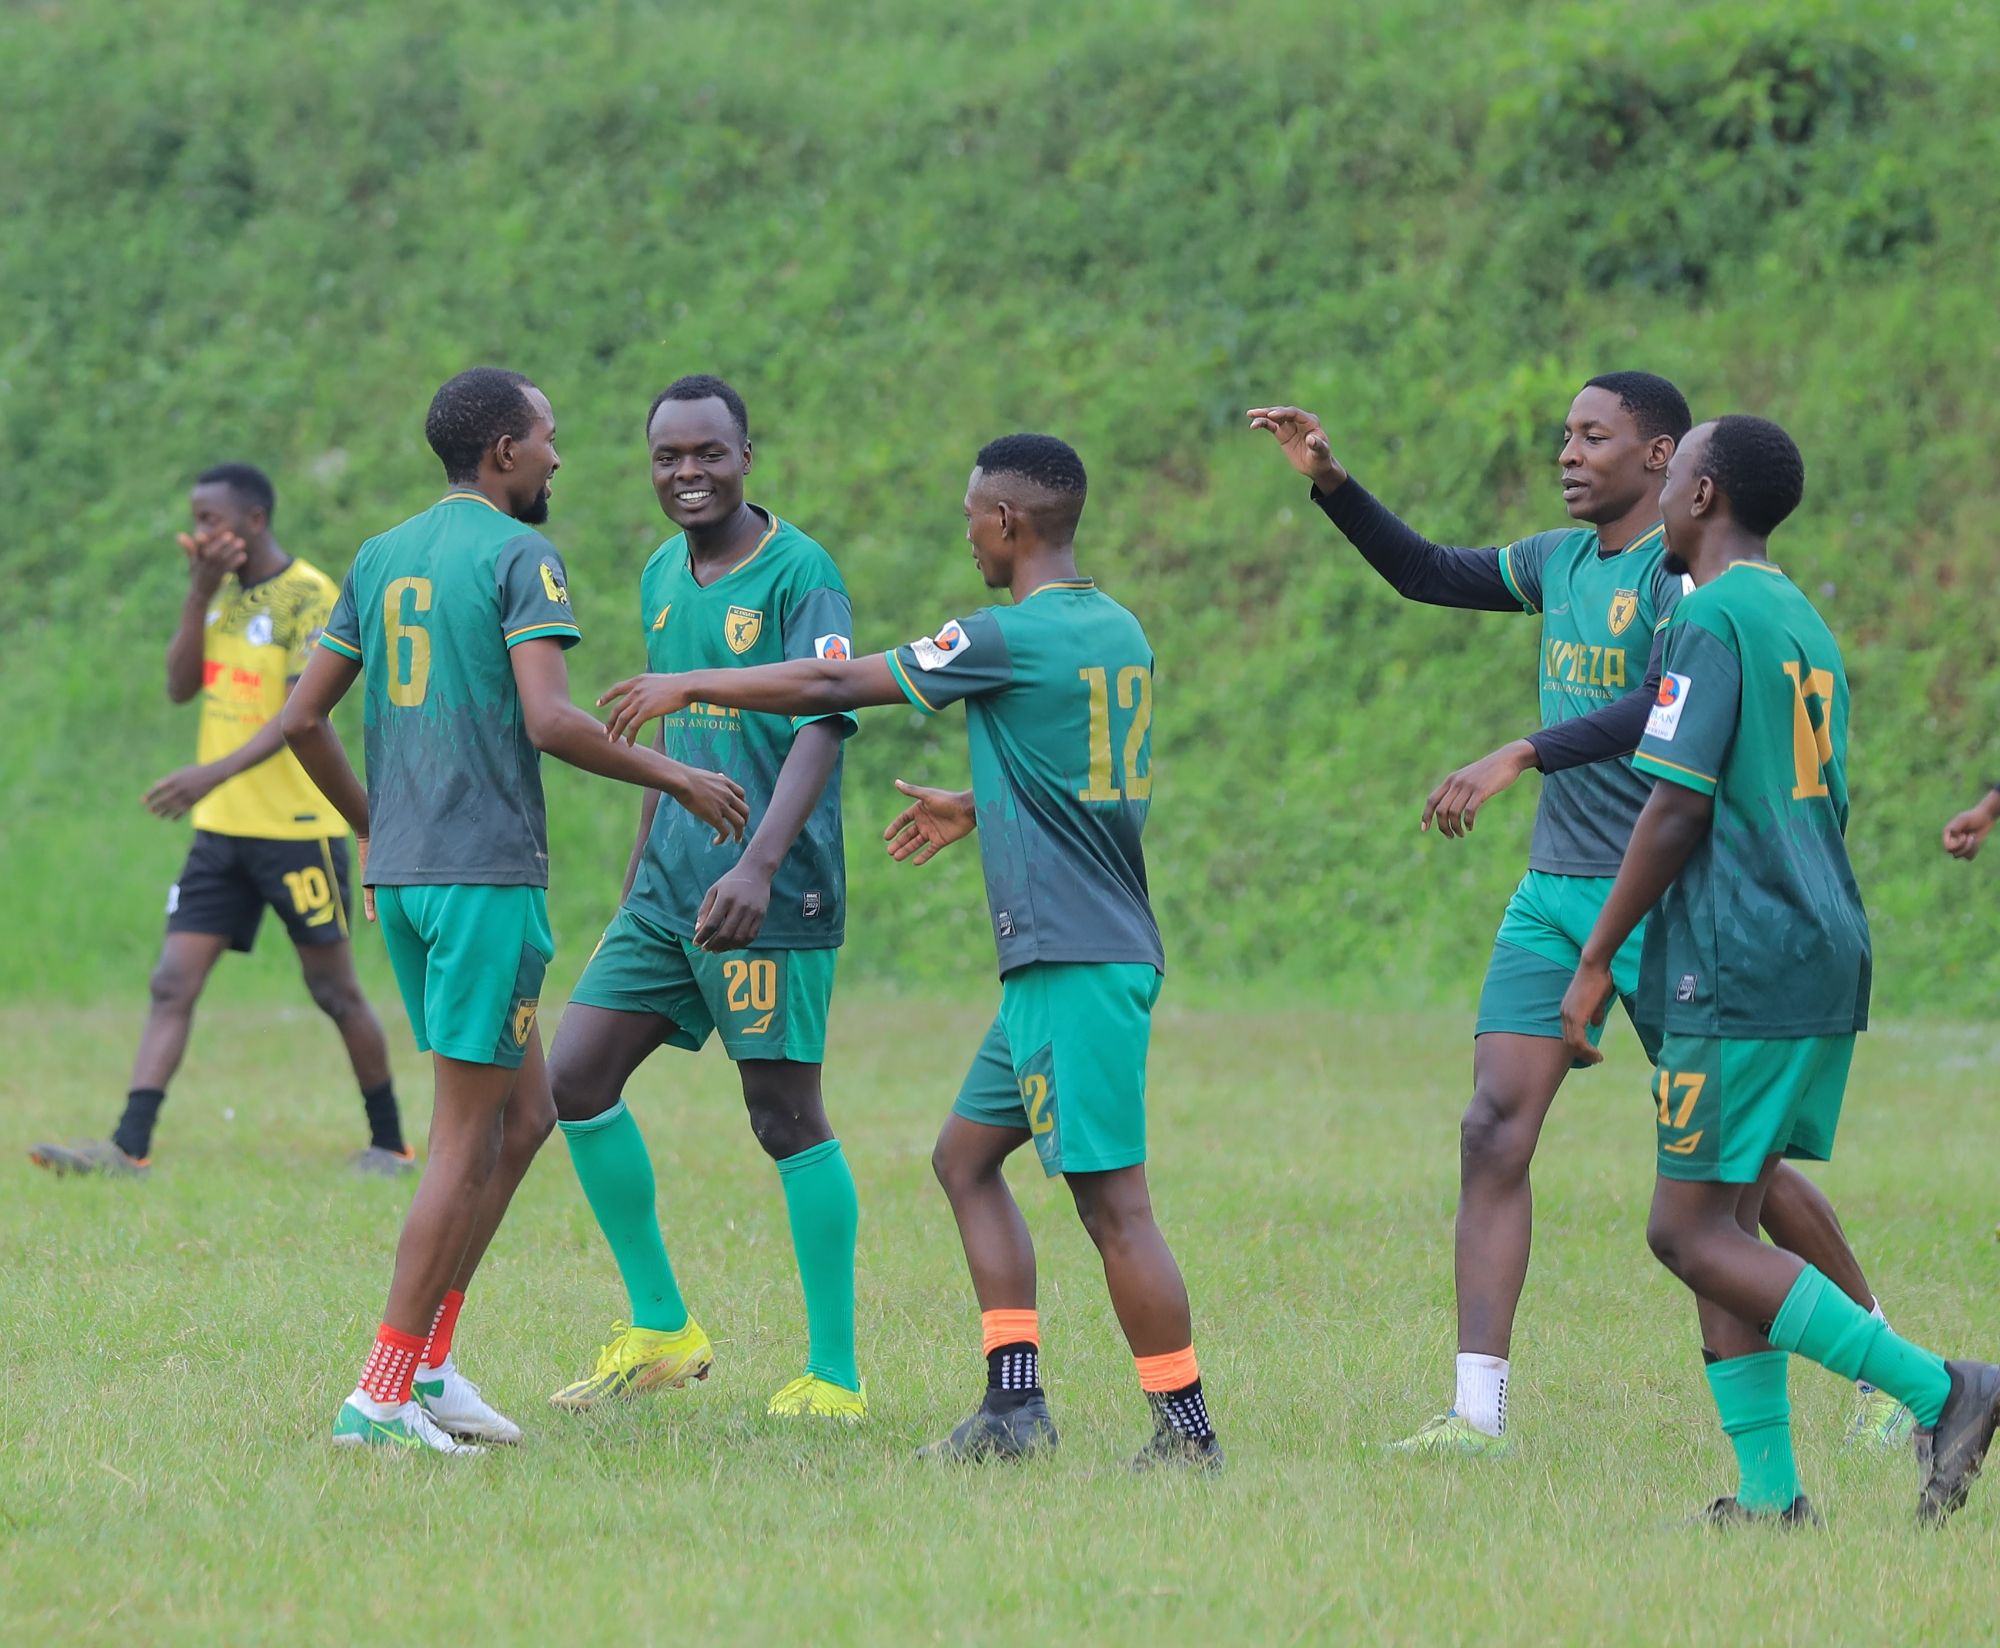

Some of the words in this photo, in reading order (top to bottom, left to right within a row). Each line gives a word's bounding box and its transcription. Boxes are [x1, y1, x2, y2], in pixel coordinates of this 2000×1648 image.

[383, 576, 433, 708] 6
[1078, 665, 1153, 802] 12
[282, 866, 331, 915] 10
[723, 959, 777, 1012] 20
[1658, 1070, 1707, 1129] 17
